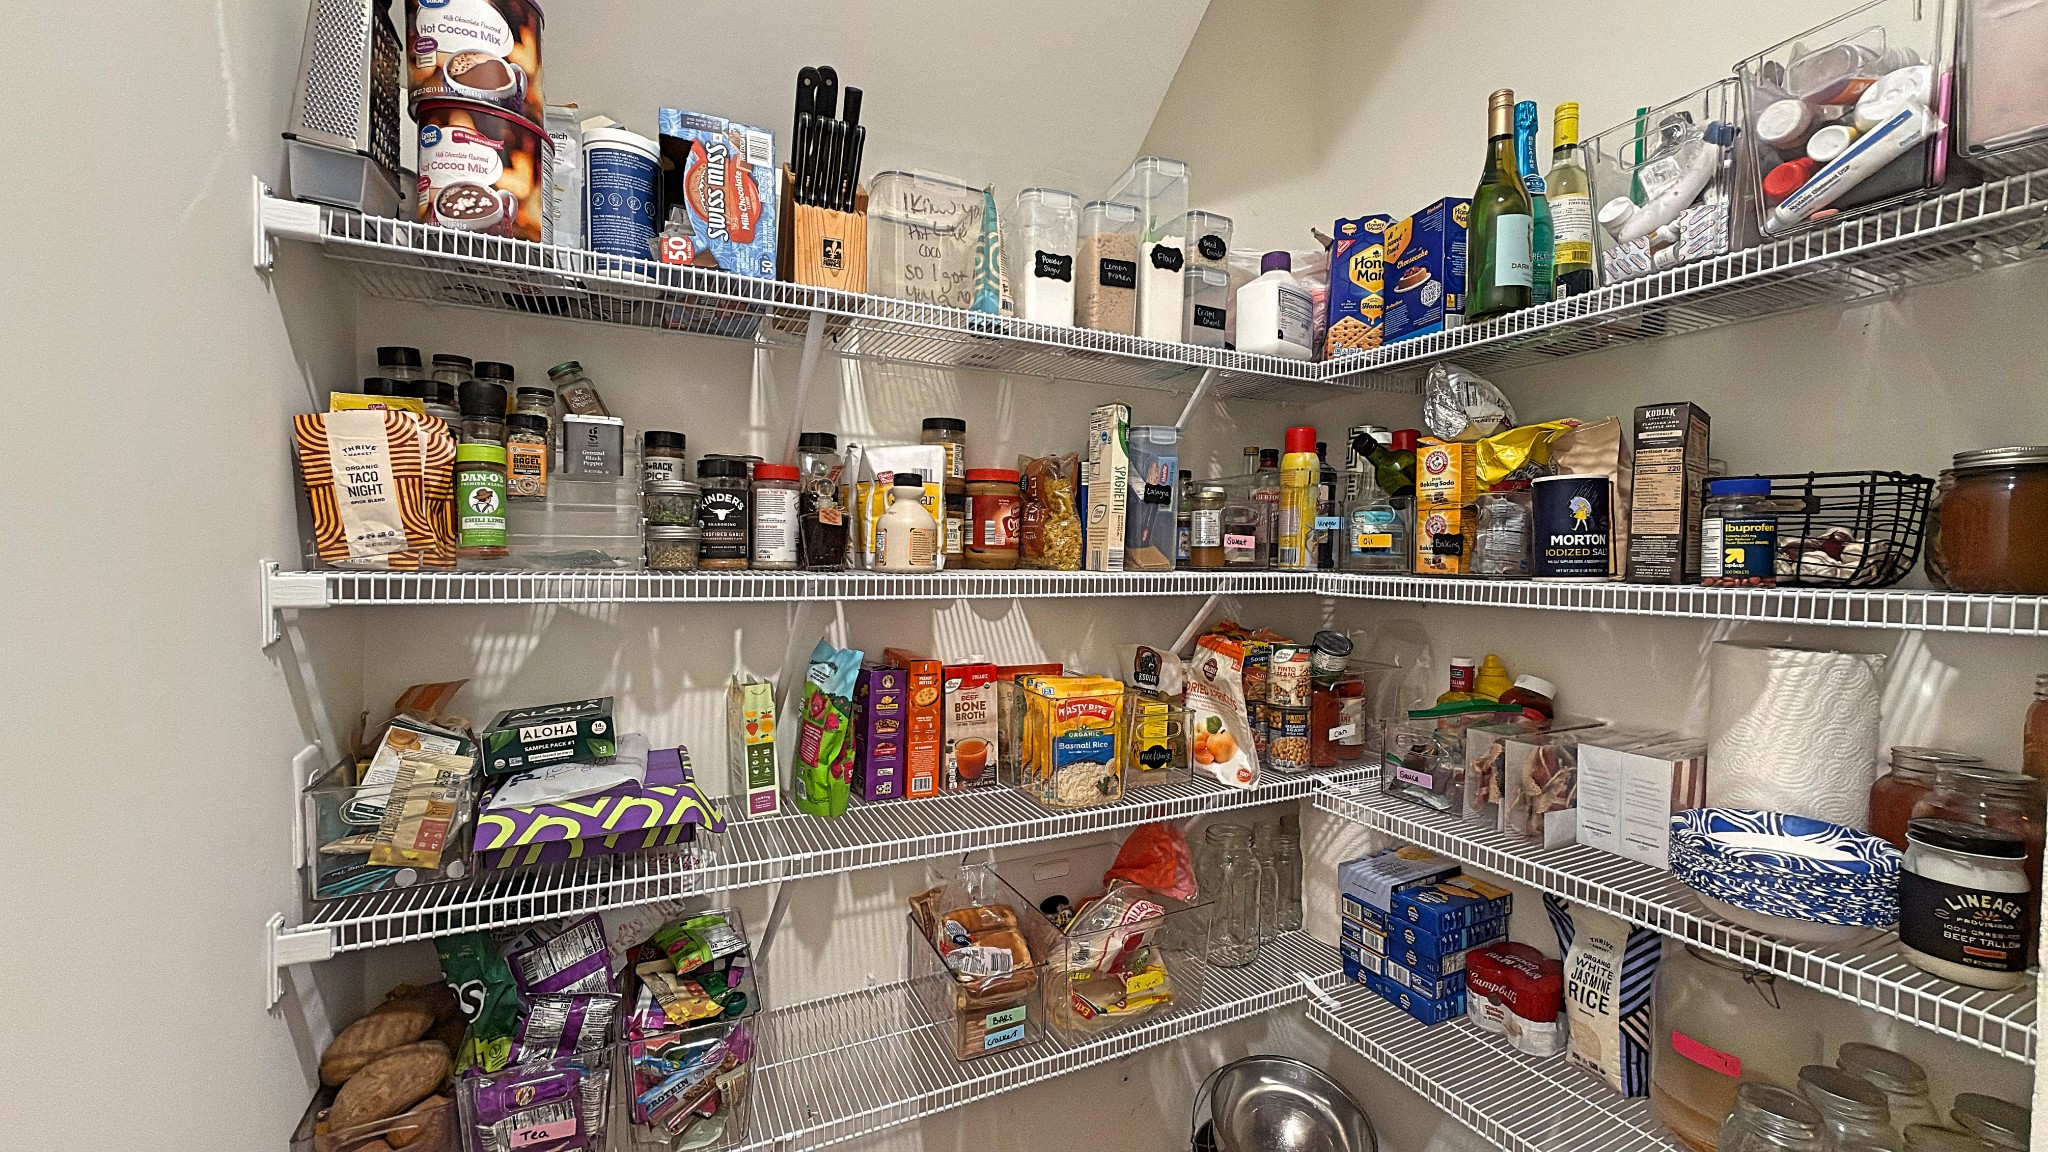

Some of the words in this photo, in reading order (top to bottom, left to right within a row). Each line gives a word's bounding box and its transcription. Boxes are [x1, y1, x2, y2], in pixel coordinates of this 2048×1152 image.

[420, 24, 436, 34] Hot
[437, 23, 478, 39] Cocoa
[480, 31, 501, 46] Mix
[422, 130, 437, 140] Great
[431, 161, 465, 171] Cocoa
[468, 162, 489, 175] Mix
[705, 142, 729, 187] MISS
[734, 171, 746, 212] Chocolate
[1811, 173, 1840, 199] Ointment
[706, 186, 730, 243] SWISS
[741, 208, 750, 231] Milk
[668, 236, 687, 262] 50
[761, 260, 774, 275] 50
[1645, 407, 1677, 419] KODIAK
[342, 445, 378, 454] THRIVE
[345, 463, 379, 472] ORGANIC
[513, 457, 541, 465] BAGEL
[347, 470, 379, 484] TACO
[347, 483, 384, 498] NIGHT
[1112, 465, 1127, 514] SPAGHETTI
[700, 492, 745, 511] KINDER'S
[1724, 522, 1775, 533] Ibuprofen
[1434, 538, 1460, 554] Baking
[1550, 533, 1607, 546] MORTON
[1545, 548, 1591, 557] IODIZED
[511, 703, 599, 719] ALOHA
[954, 700, 987, 712] BONE
[955, 711, 985, 721] BROTH
[522, 724, 575, 740] ALOHA
[524, 743, 549, 752] SAMPLE
[550, 741, 567, 749] PACK
[1059, 741, 1091, 749] Basmati
[1092, 741, 1108, 749] Rice
[1944, 893, 2022, 919] LINEAGE
[1589, 937, 1615, 950] THRIVE
[1943, 930, 1977, 943] BEEF
[1583, 952, 1611, 969] ORGANIC
[1576, 956, 1614, 981] WHITE
[1471, 972, 1518, 1004] Campbell's
[1571, 967, 1612, 996] JASMINE
[1568, 980, 1610, 1016] RICE
[520, 1129, 549, 1142] Tea
